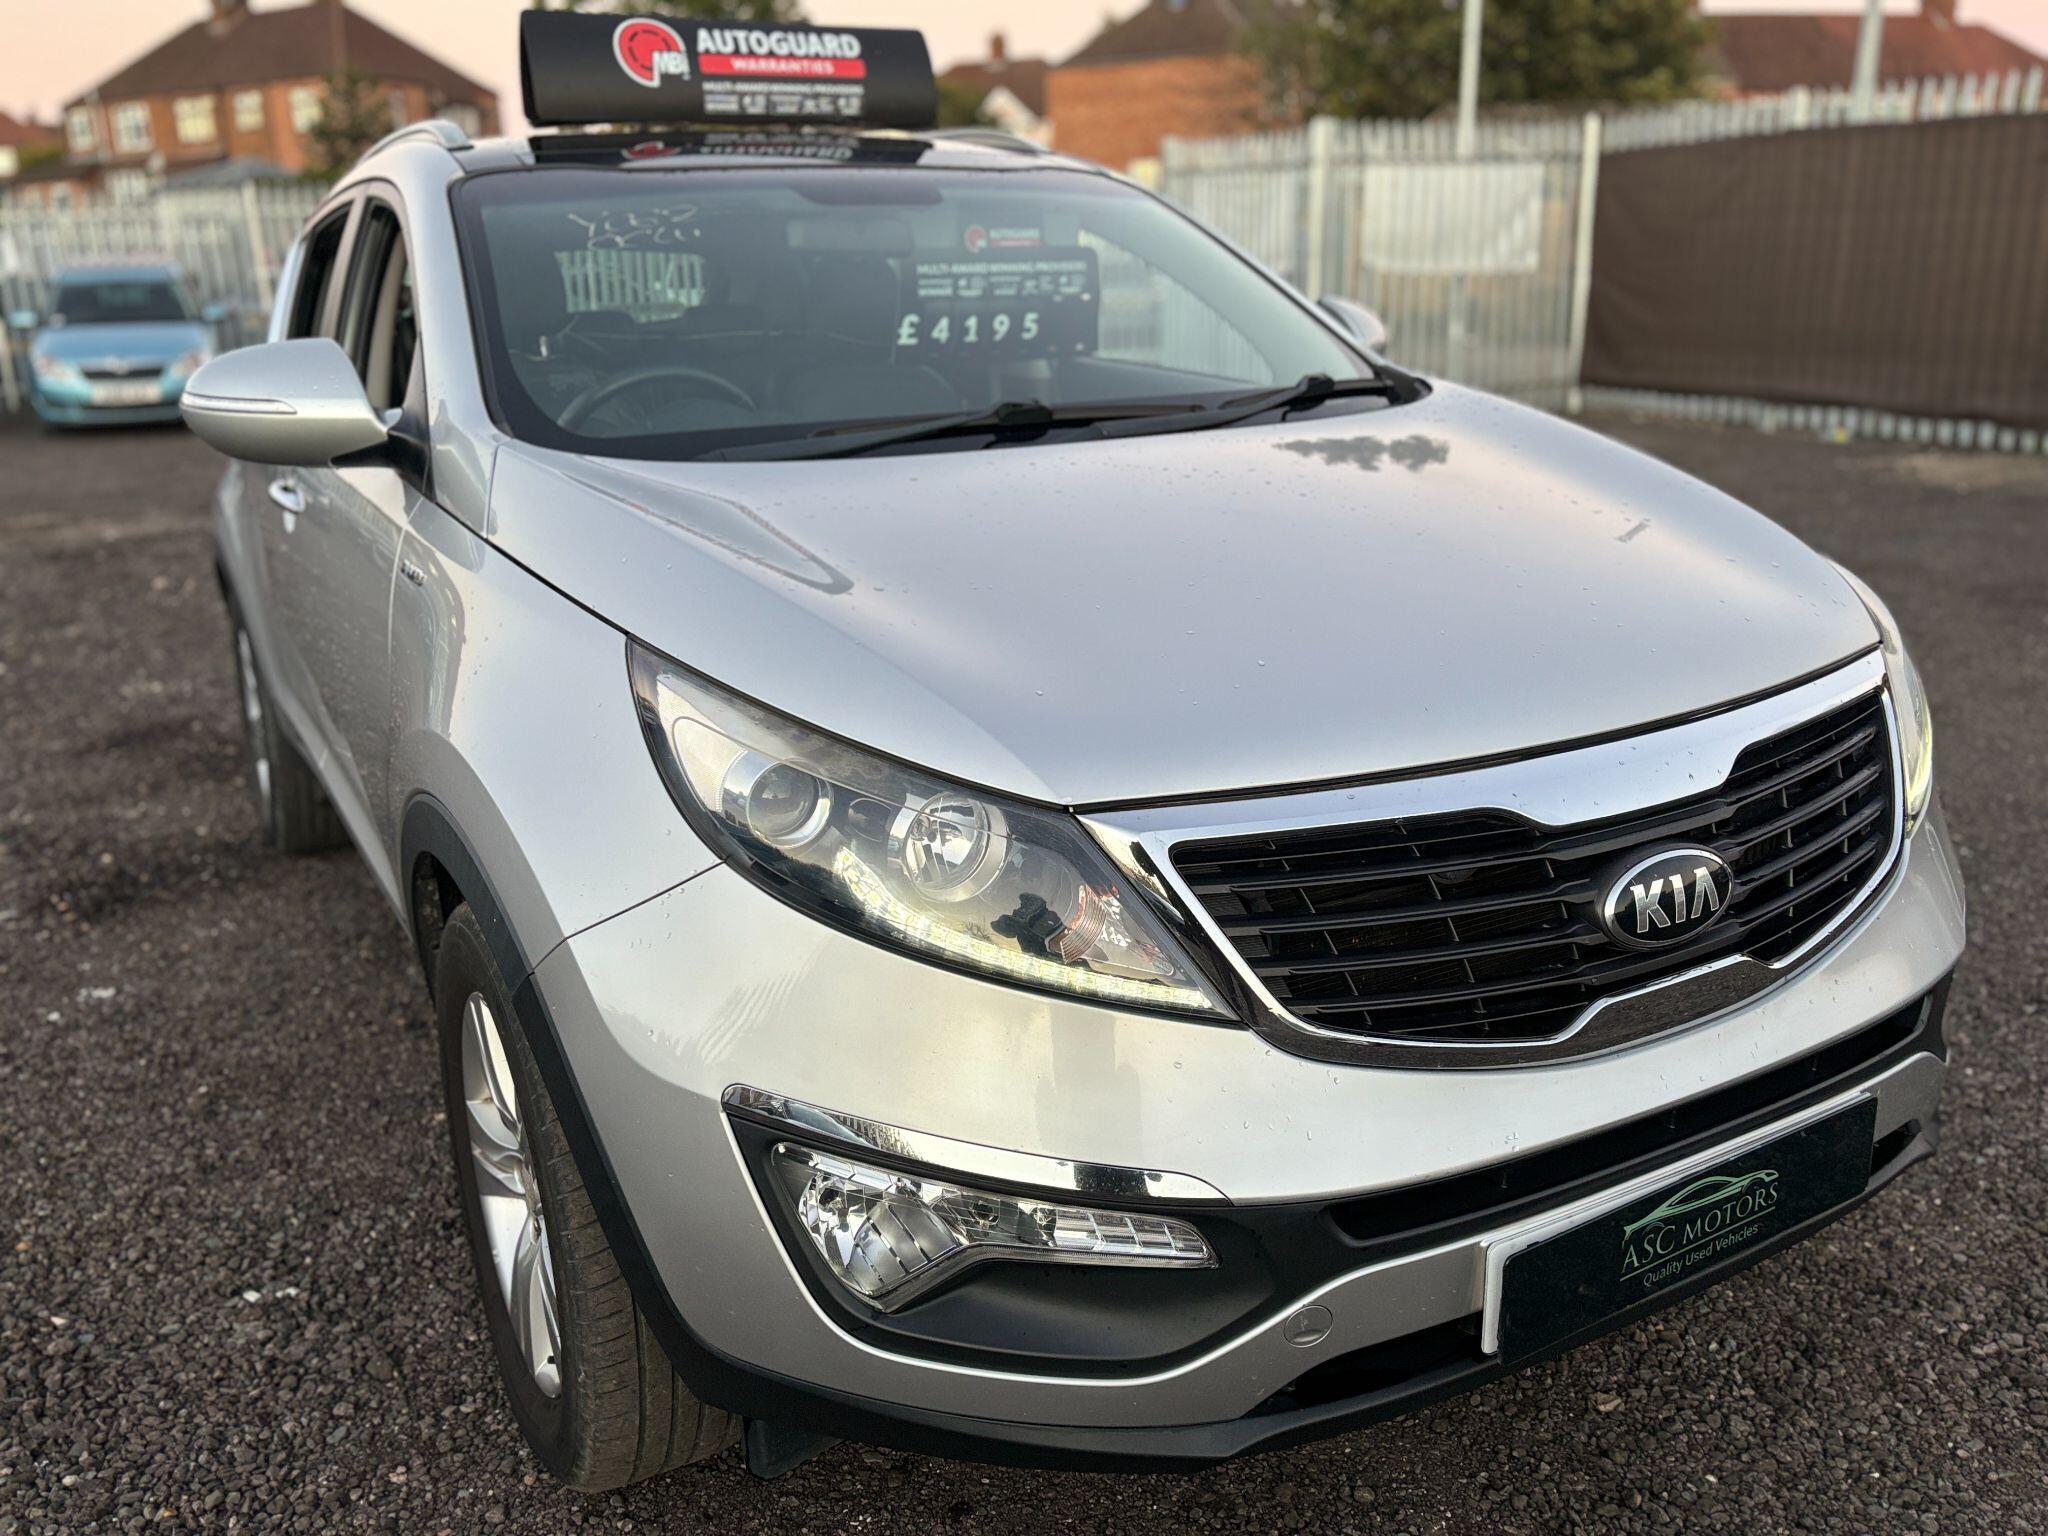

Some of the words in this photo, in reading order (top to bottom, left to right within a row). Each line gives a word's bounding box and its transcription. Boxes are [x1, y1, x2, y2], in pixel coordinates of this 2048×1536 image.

[697, 28, 862, 59] AUTOGUARD
[730, 58, 835, 75] WARRANTIES
[1629, 866, 1720, 933] KIA
[1621, 1225, 1676, 1274] ASC
[1682, 1182, 1778, 1244] MOTORS
[1643, 1259, 1684, 1287] Quality
[1685, 1241, 1713, 1266] Used
[1715, 1224, 1759, 1252] Vehicles
